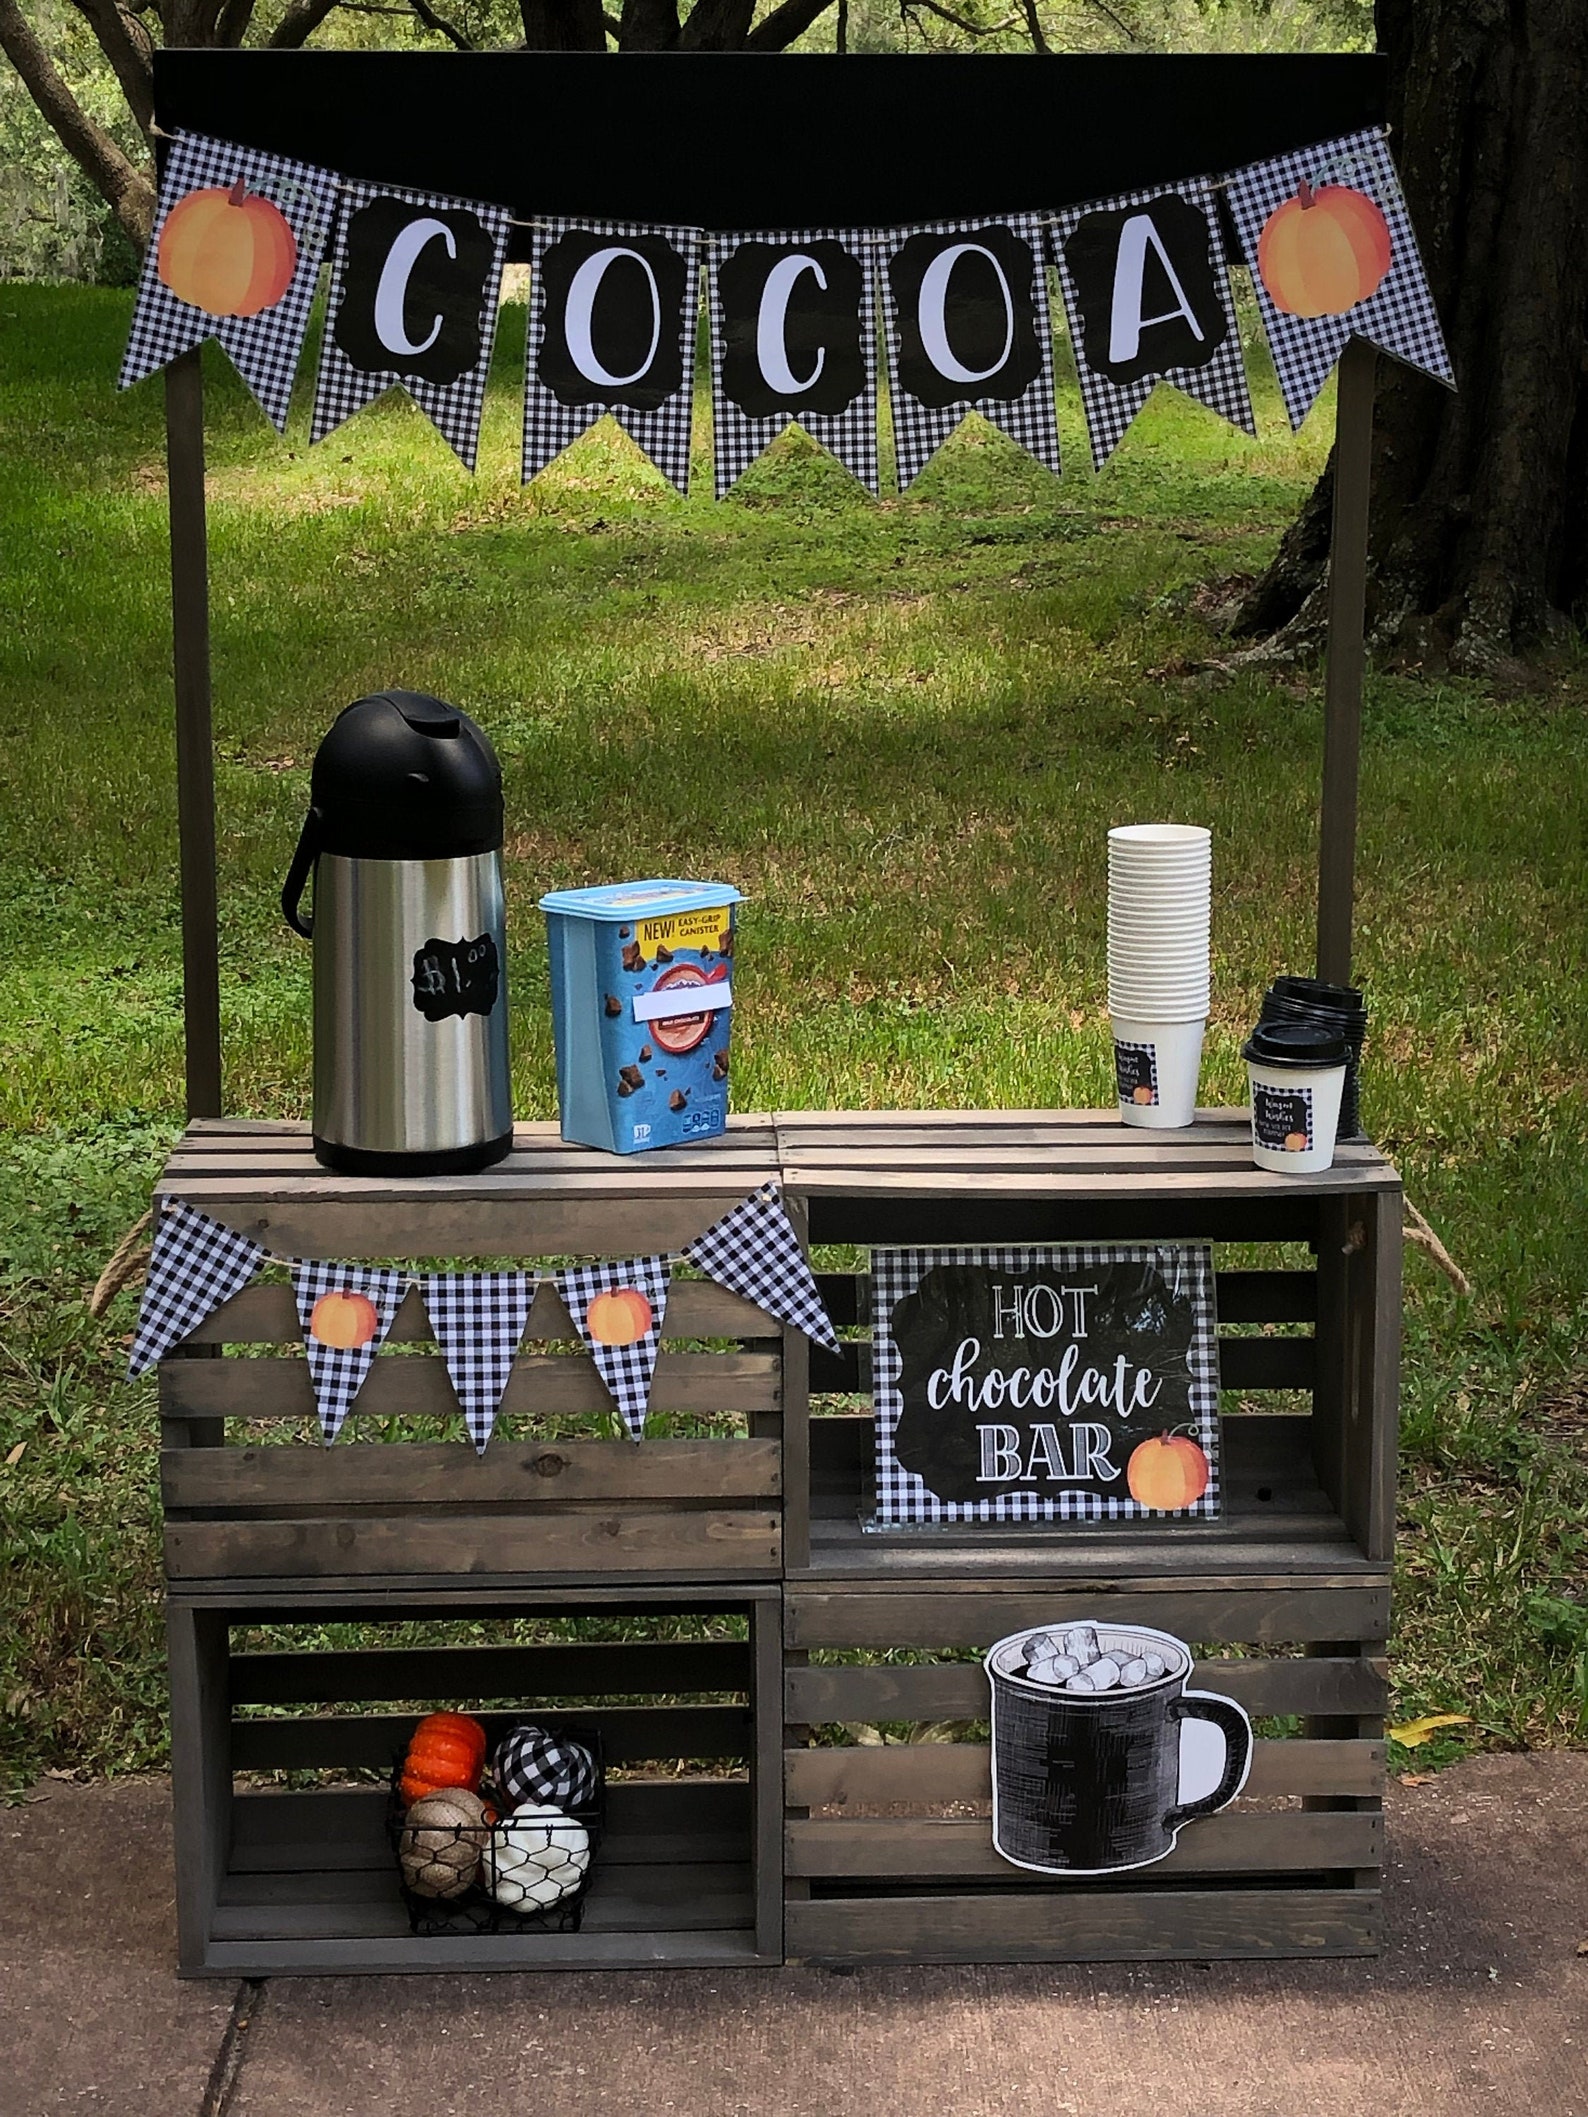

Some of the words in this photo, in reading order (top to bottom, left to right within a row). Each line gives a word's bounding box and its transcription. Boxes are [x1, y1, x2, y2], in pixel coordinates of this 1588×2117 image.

[373, 213, 1206, 395] COCOA
[643, 920, 676, 941] NEW!
[678, 913, 722, 927] EASY-GRIP
[679, 924, 720, 937] CANISTER
[991, 1283, 1099, 1340] HOT
[926, 1336, 1164, 1419] chocolate
[974, 1422, 1122, 1483] BAR
